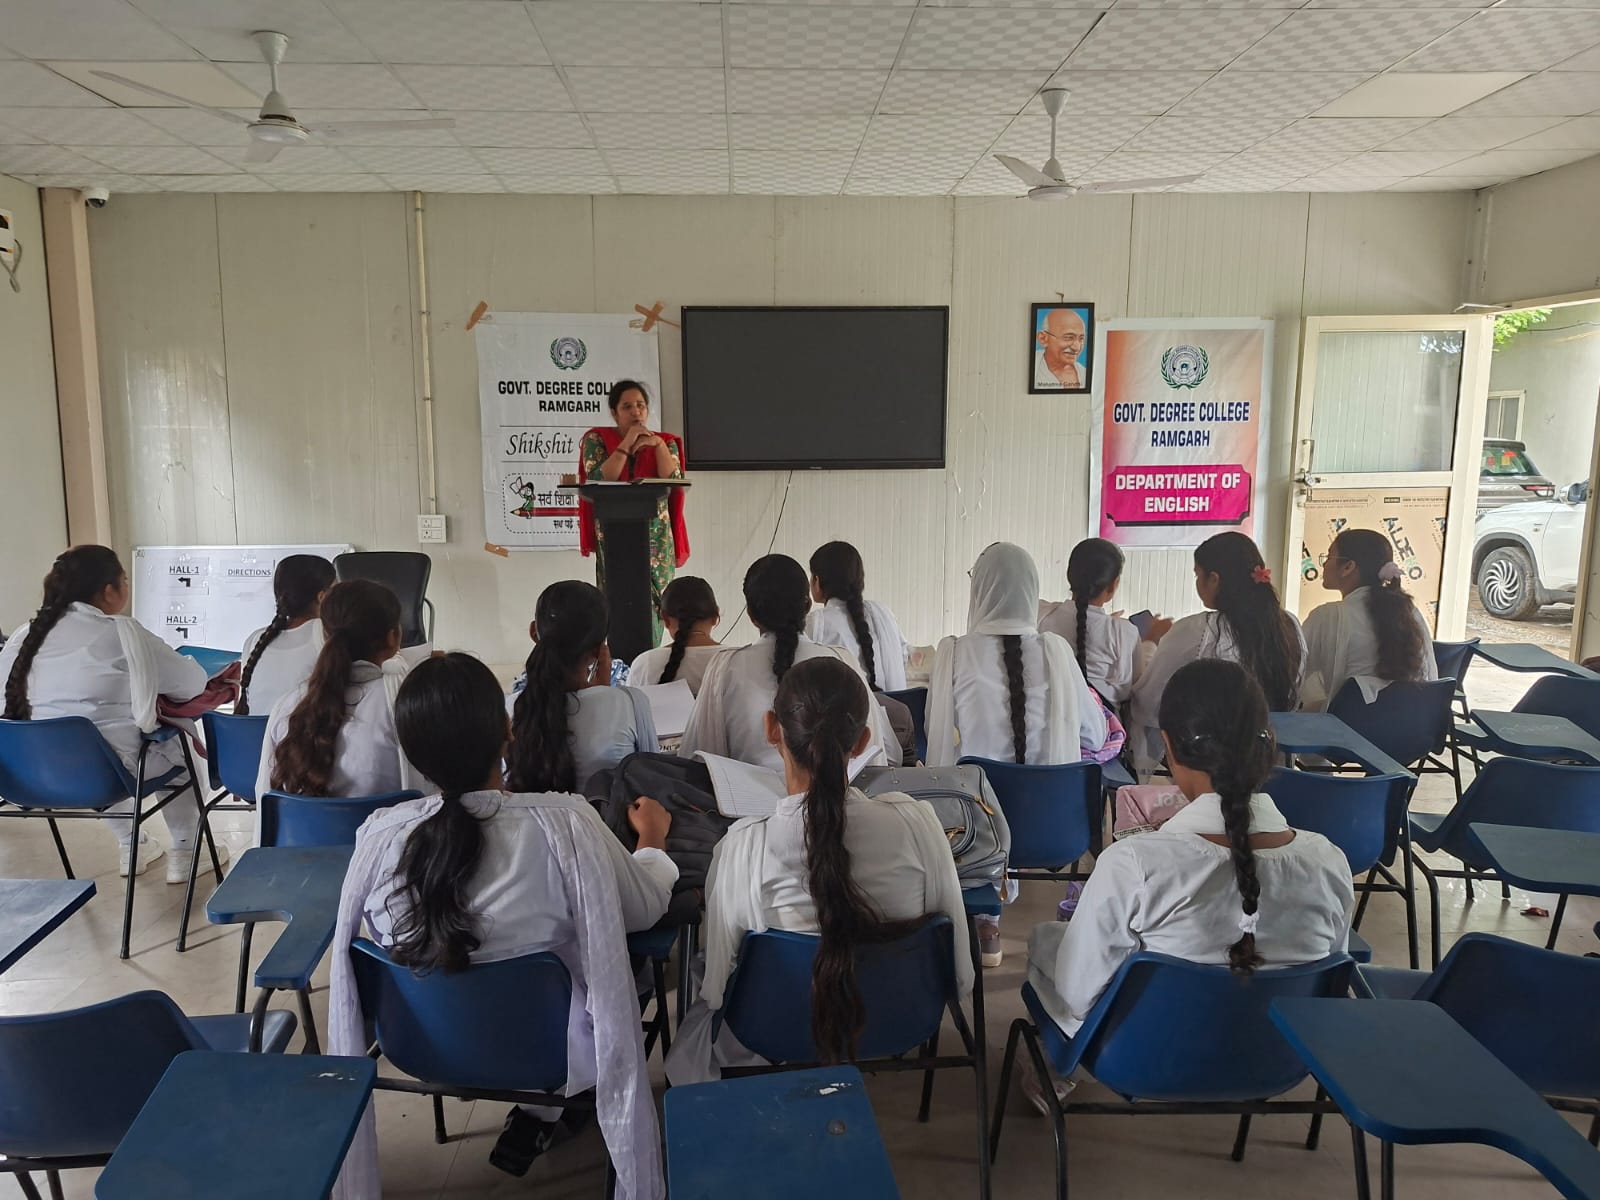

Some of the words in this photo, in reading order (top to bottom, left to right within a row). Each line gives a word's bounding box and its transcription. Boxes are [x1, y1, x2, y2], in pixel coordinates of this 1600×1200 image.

[498, 380, 532, 395] GOVT.
[536, 381, 584, 395] DEGREE
[539, 400, 601, 412] RAMGARH
[1114, 403, 1146, 422] GOVT.
[1150, 403, 1195, 421] DEGREE
[1199, 402, 1250, 421] COLLEGE
[506, 432, 574, 459] Shikshit
[1151, 430, 1210, 447] RAMGARH
[1115, 473, 1217, 490] DEPARTMENT
[1221, 473, 1241, 489] OF
[1144, 497, 1209, 513] ENGLISH
[169, 565, 200, 574] HALL-1
[227, 568, 271, 577] DIRECTIONS
[166, 616, 197, 624] HALL-2
